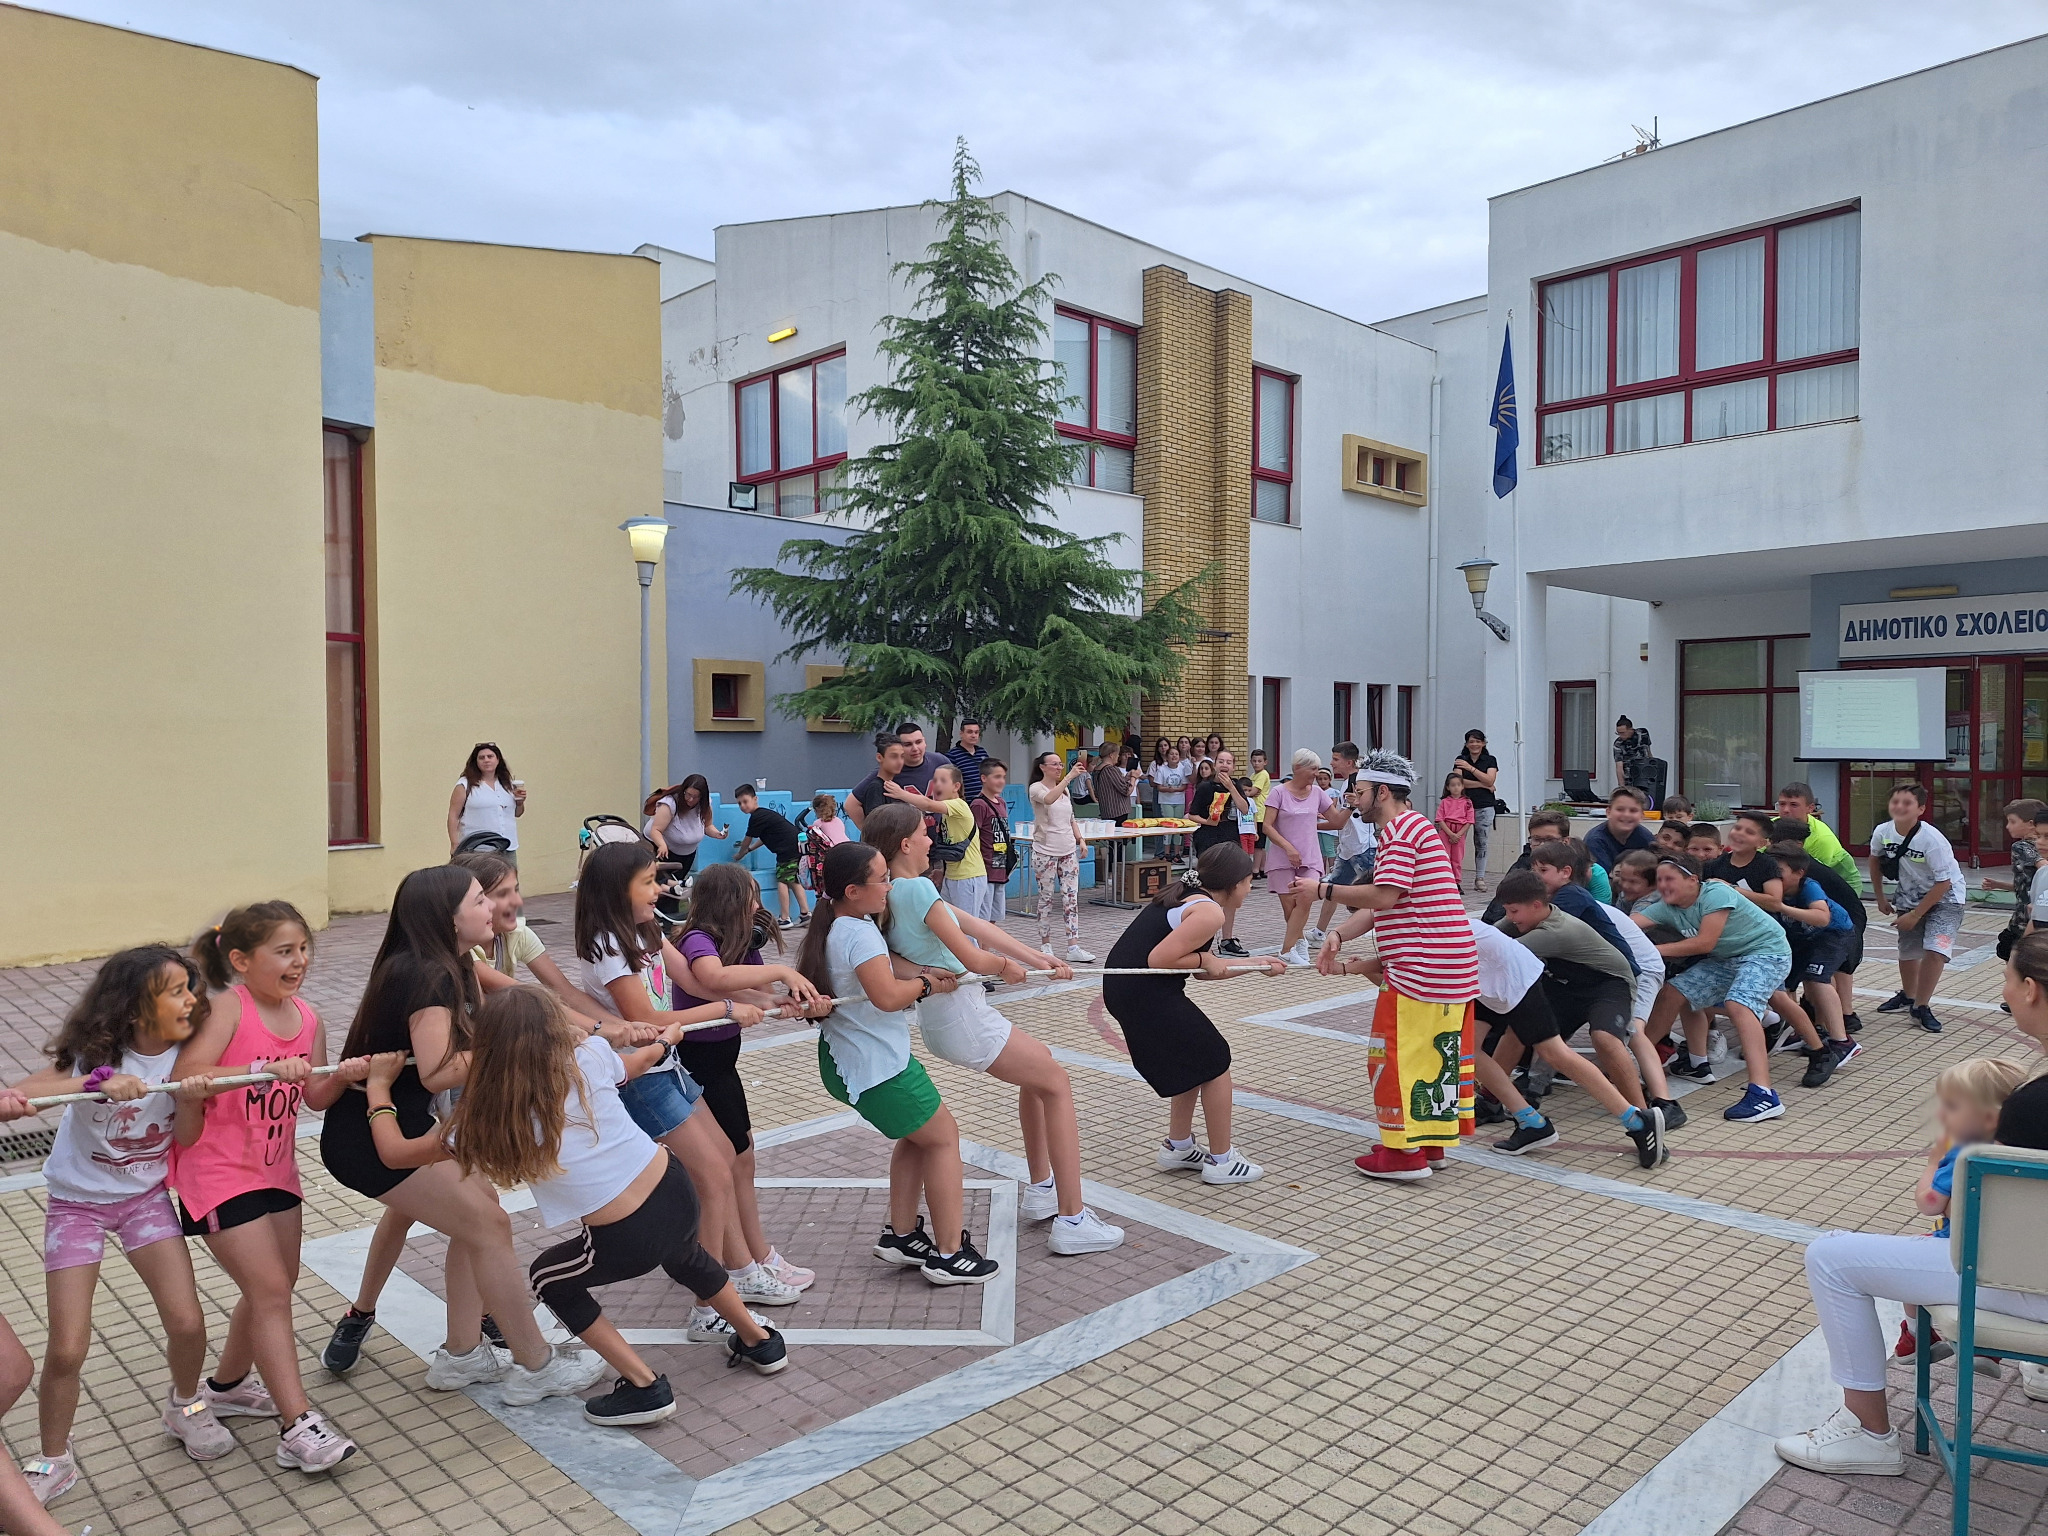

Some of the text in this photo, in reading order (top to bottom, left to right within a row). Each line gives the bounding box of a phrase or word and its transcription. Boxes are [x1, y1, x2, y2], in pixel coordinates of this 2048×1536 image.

[1844, 608, 2048, 643] ΔΗΜΟΤΙΚΟ ΣΧΟΛΕΙΟ
[246, 1086, 301, 1121] MOR
